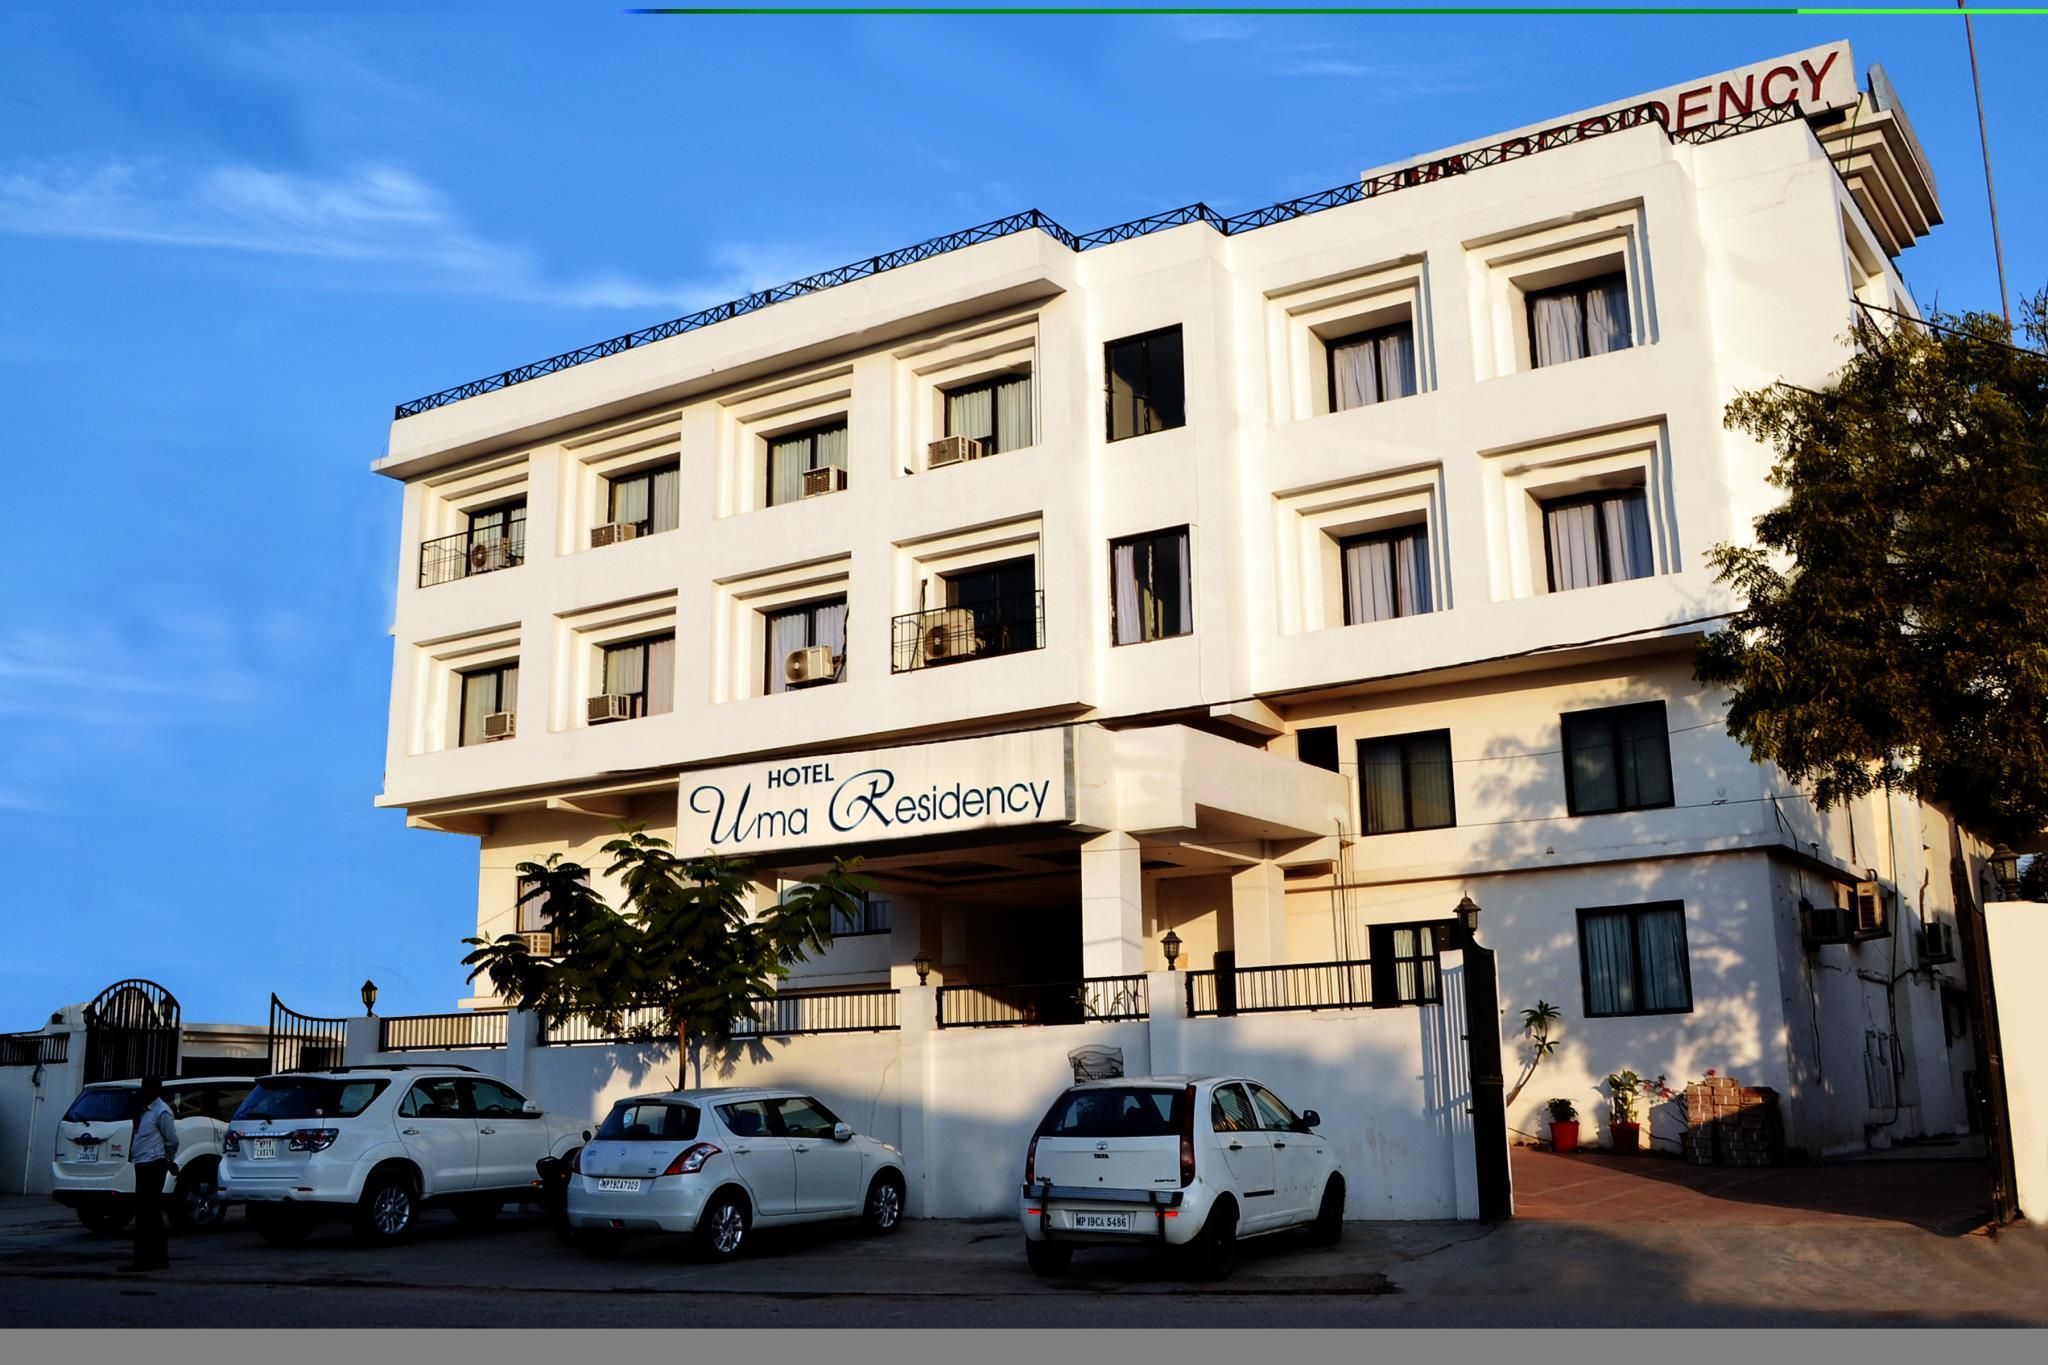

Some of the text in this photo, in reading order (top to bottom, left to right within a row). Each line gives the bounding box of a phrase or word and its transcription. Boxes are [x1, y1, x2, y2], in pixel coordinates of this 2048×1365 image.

[767, 762, 835, 789] HOTEL
[689, 768, 1050, 845] Uma Residency
[1075, 1215, 1086, 1226] MP
[1106, 1216, 1127, 1227] 5486
